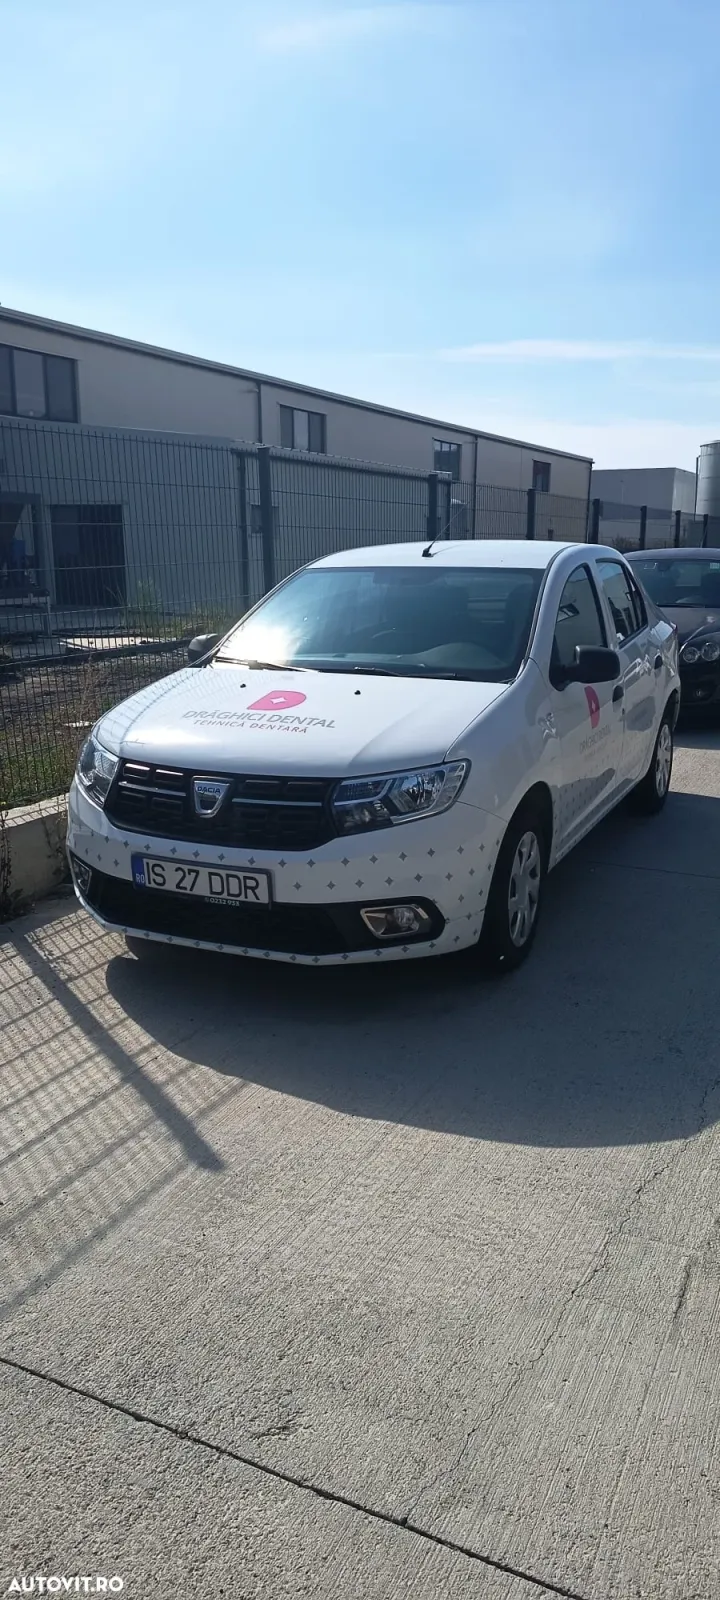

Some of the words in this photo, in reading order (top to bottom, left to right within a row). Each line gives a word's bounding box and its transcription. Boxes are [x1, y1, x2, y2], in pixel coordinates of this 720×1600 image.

[266, 713, 337, 729] DENTAL
[197, 786, 221, 794] DACIA
[135, 873, 145, 884] RO
[145, 861, 166, 887] IS
[174, 866, 200, 892] 27
[207, 871, 260, 901] DDR
